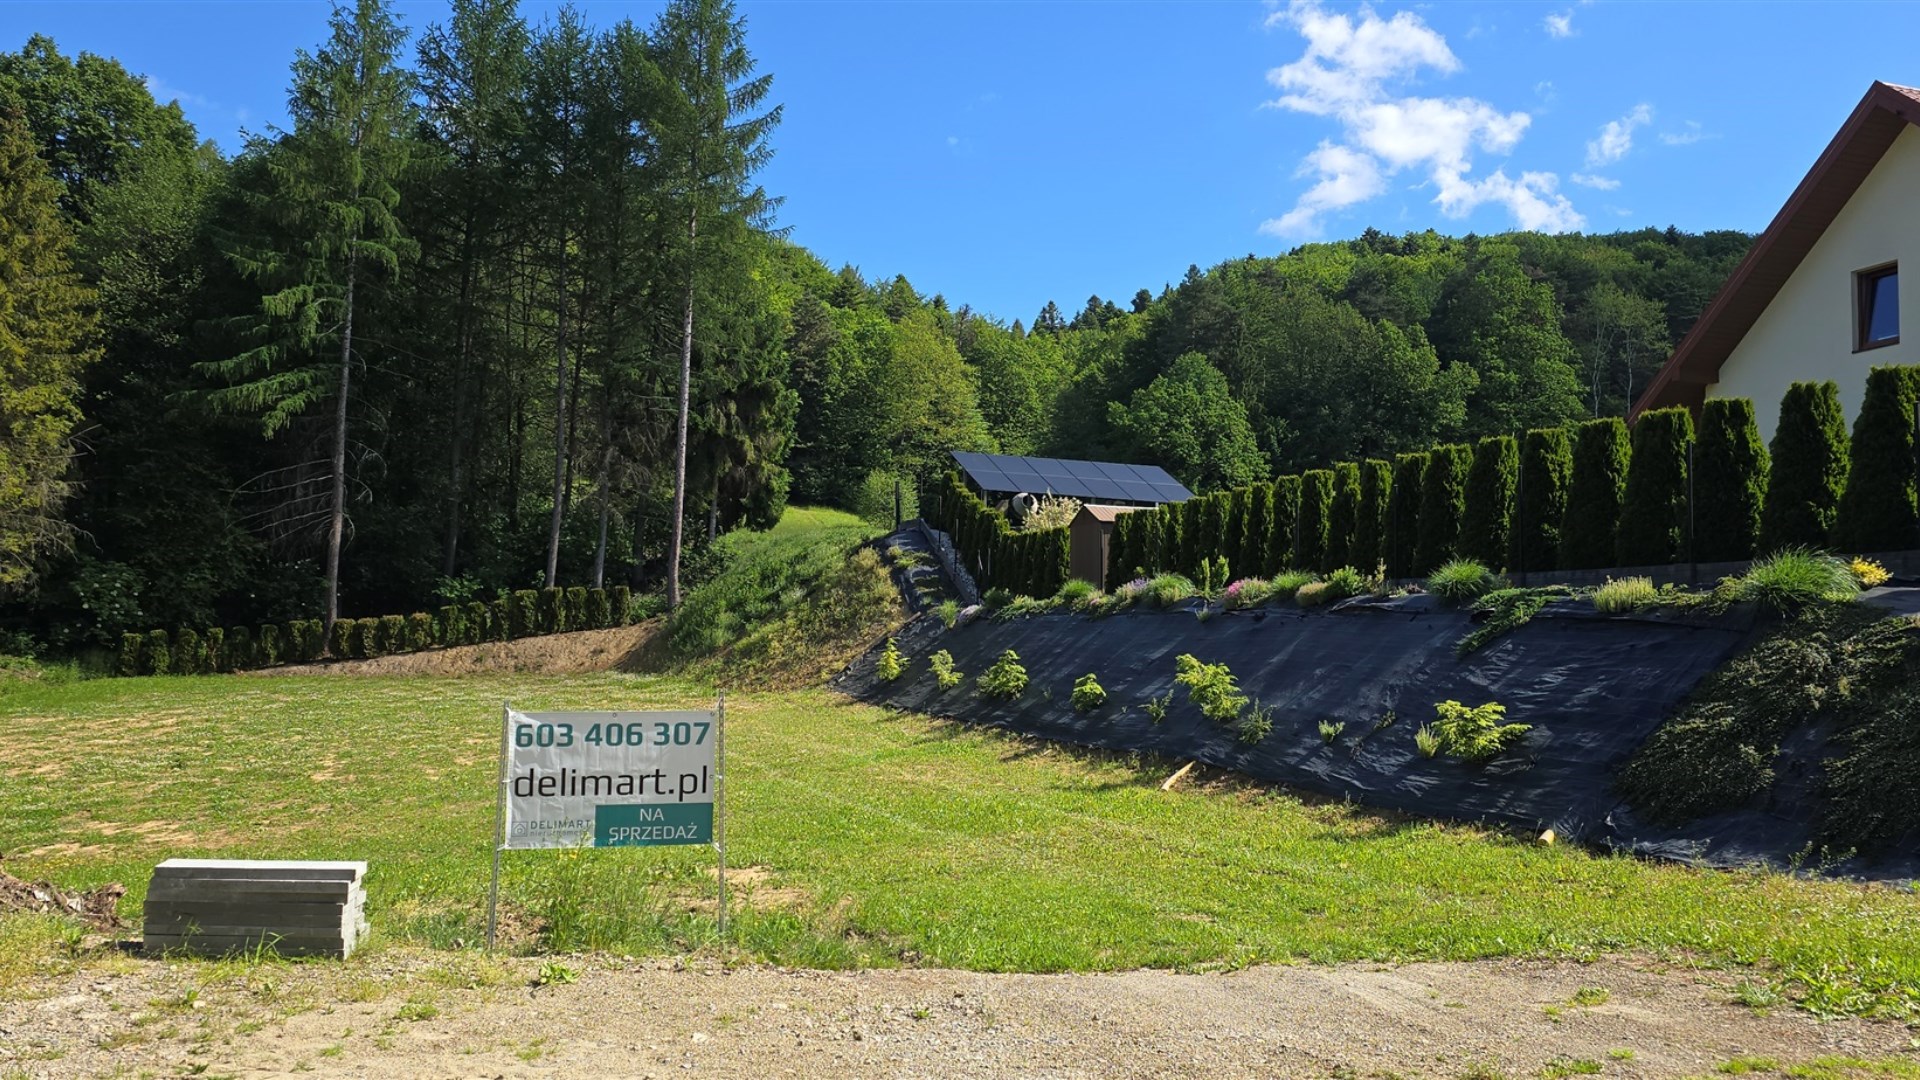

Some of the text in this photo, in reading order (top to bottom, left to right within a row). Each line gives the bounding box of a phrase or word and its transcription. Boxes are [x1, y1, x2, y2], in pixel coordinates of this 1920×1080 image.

[515, 721, 711, 748] 603 406 307
[514, 765, 708, 802] delimart.pl
[530, 820, 591, 830] DELIMART
[639, 808, 664, 821] NA
[608, 821, 698, 842] SPRZEDAŻ
